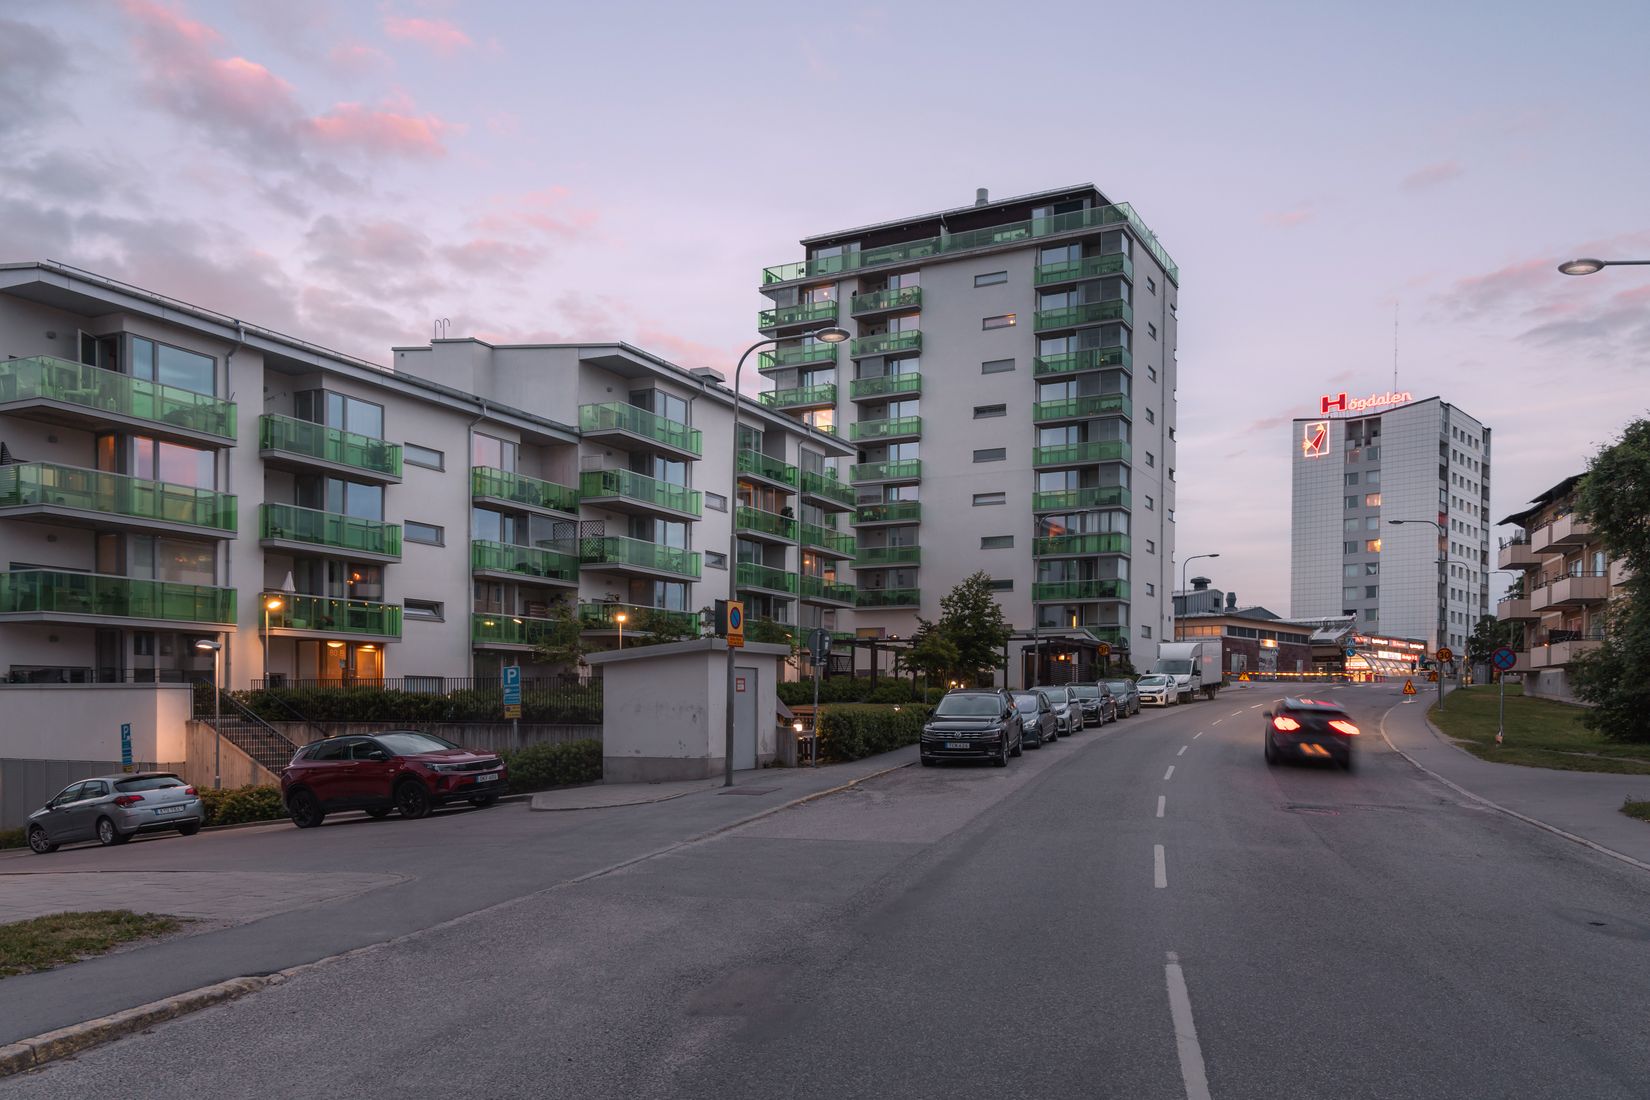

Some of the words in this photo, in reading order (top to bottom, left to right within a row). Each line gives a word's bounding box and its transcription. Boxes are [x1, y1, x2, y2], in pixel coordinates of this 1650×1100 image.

[1321, 392, 1412, 415] Högdalen
[1439, 651, 1450, 659] 30
[507, 669, 517, 684] P
[123, 725, 129, 739] P
